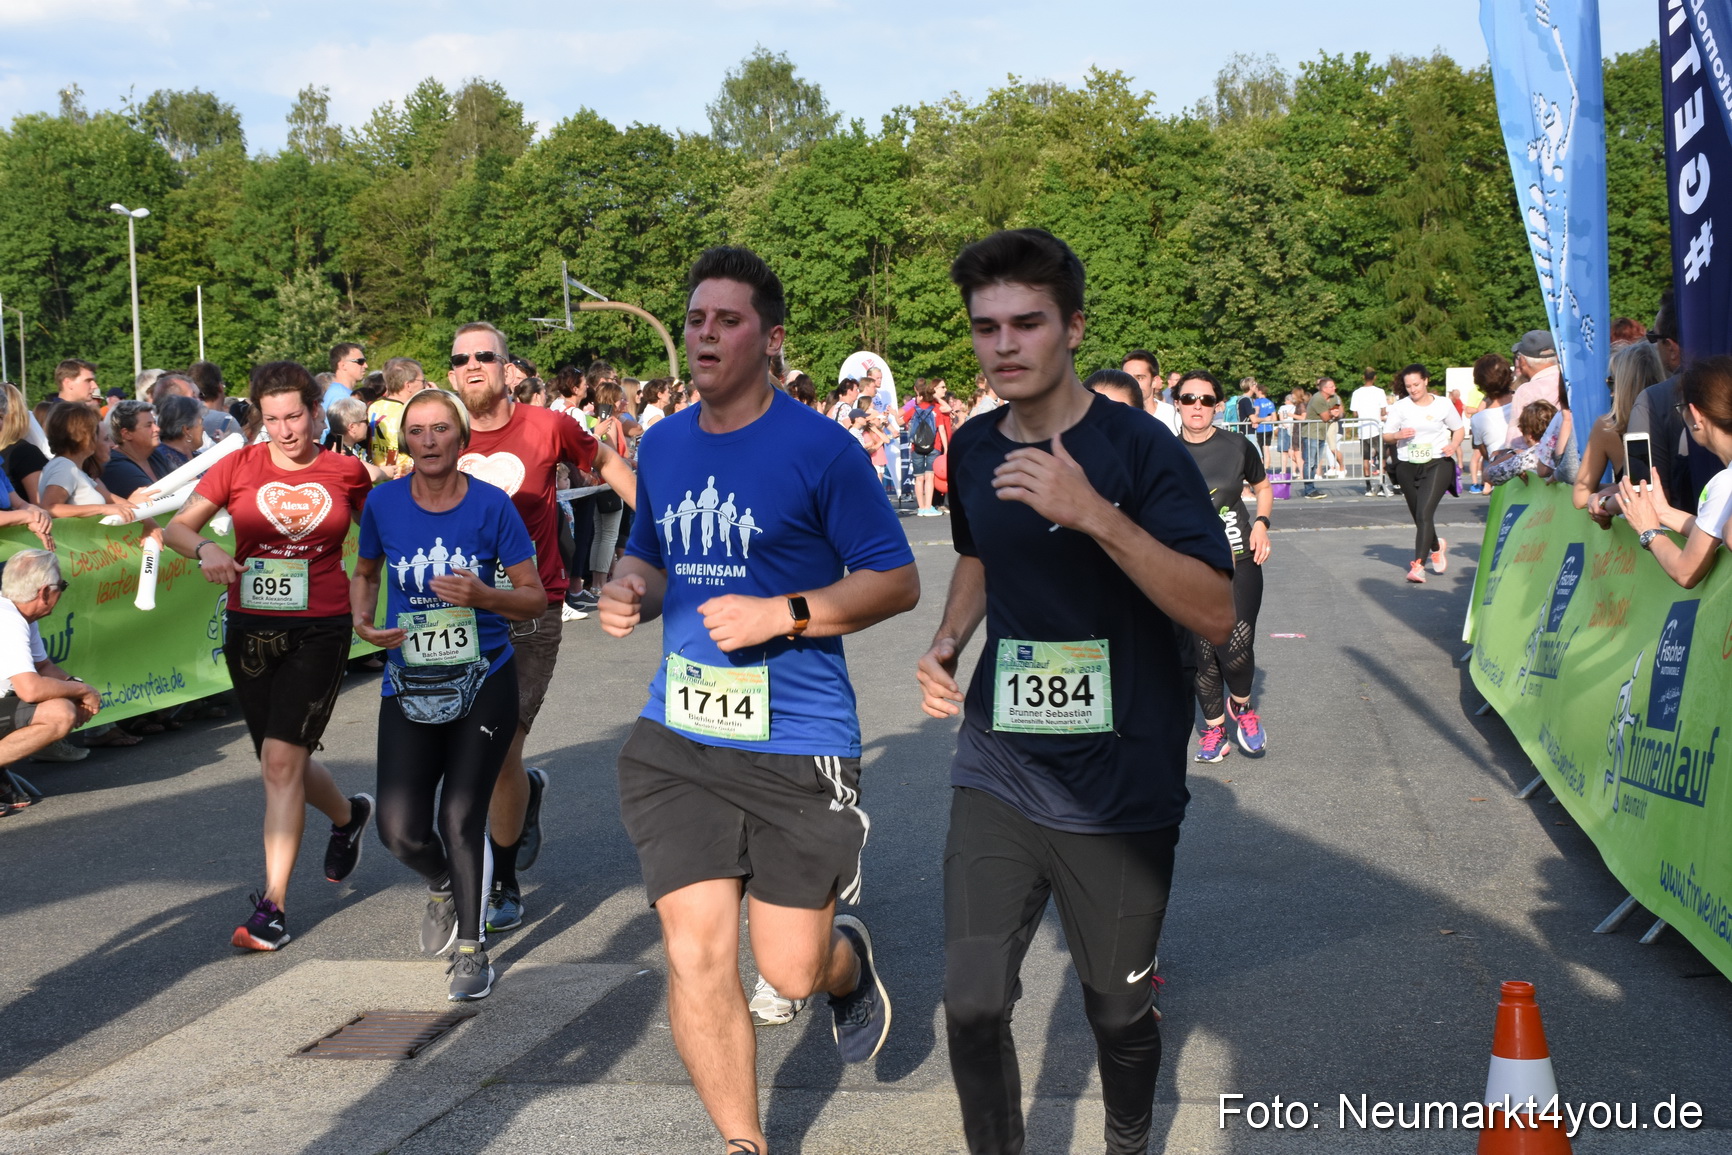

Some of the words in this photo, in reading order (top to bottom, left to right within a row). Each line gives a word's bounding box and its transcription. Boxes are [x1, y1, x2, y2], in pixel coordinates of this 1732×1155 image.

[1410, 449, 1431, 458] 1356
[280, 501, 310, 511] Alexa
[69, 534, 128, 577] Gesunde
[144, 556, 154, 574] swn
[675, 563, 747, 578] GEMEINSAM
[253, 577, 291, 596] 695
[688, 577, 703, 585] INS
[706, 578, 725, 586] ZIEL
[409, 627, 469, 652] 1713
[1660, 639, 1686, 663] Fischer
[1079, 665, 1102, 673] 2019
[1008, 673, 1095, 708] 1384
[678, 686, 754, 720] 1714
[1009, 708, 1043, 718] Brunner
[1045, 709, 1093, 718] Sebastian
[717, 718, 743, 727] Martin
[1626, 713, 1721, 806] firmenlauf
